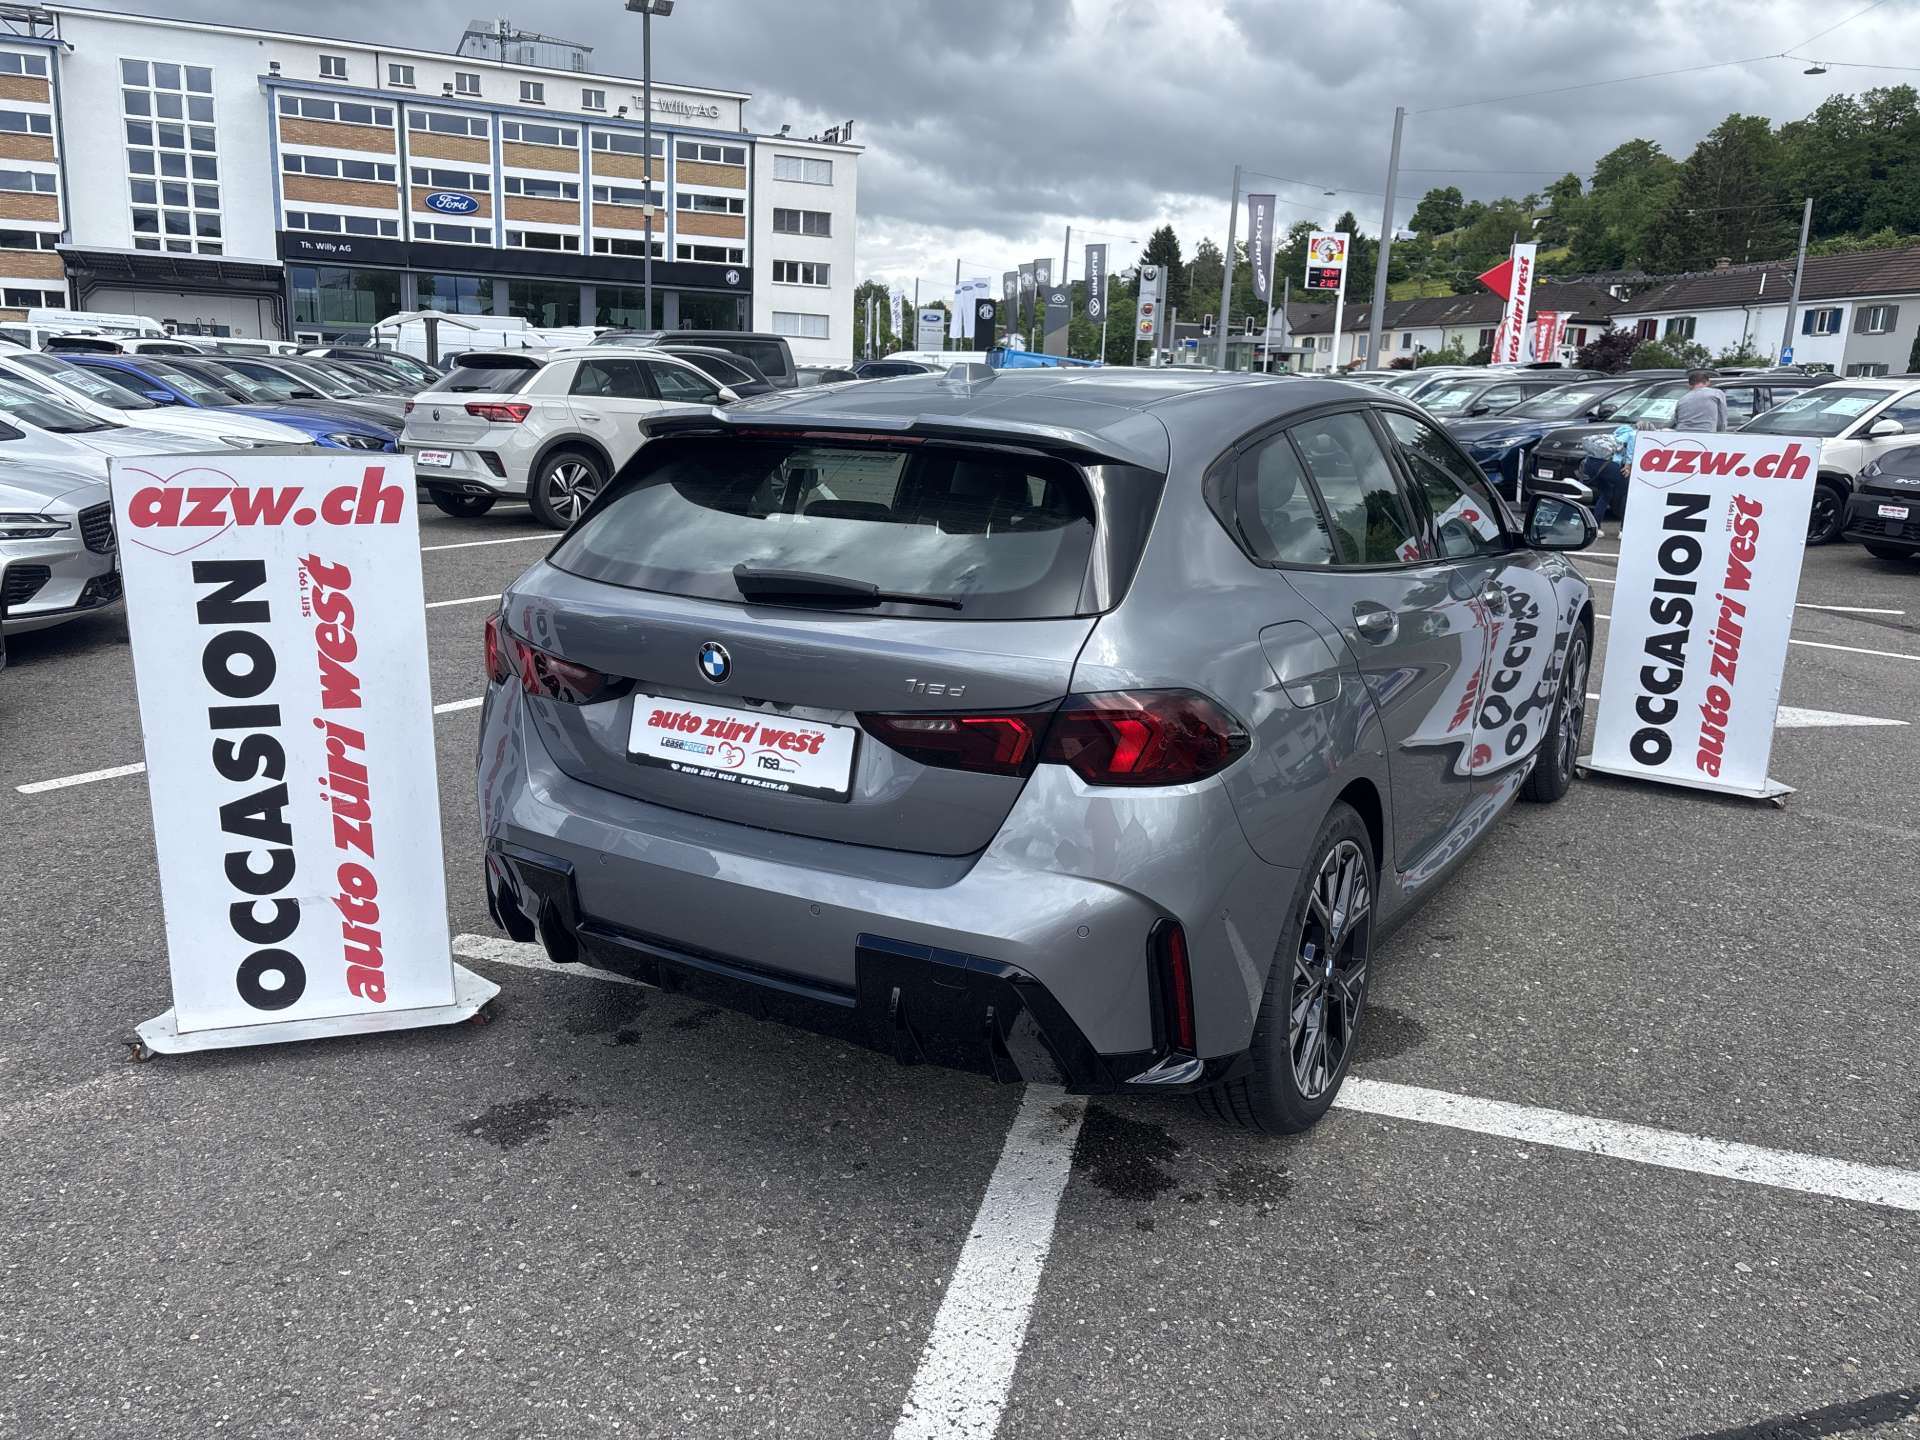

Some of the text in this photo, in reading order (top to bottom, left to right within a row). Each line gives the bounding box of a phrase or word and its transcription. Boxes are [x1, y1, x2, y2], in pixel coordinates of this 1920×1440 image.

[659, 98, 694, 118] Willy
[697, 103, 719, 118] AG
[436, 194, 468, 211] Ford
[300, 241, 351, 252] Th. Willy AG
[1509, 256, 1529, 362] uto züri west
[1640, 443, 1811, 480] azw.ch
[128, 467, 404, 528] azw.ch
[301, 595, 312, 618] SEIT
[1629, 492, 1712, 766] OCCASION
[1696, 494, 1764, 778] auto züri west
[648, 709, 825, 754] auto züri west
[298, 553, 387, 1004] auto züri west
[681, 765, 699, 774] auto
[700, 768, 717, 778] züri
[718, 772, 737, 782] west
[757, 756, 779, 770] nsa
[191, 559, 307, 1012] OCCASION
